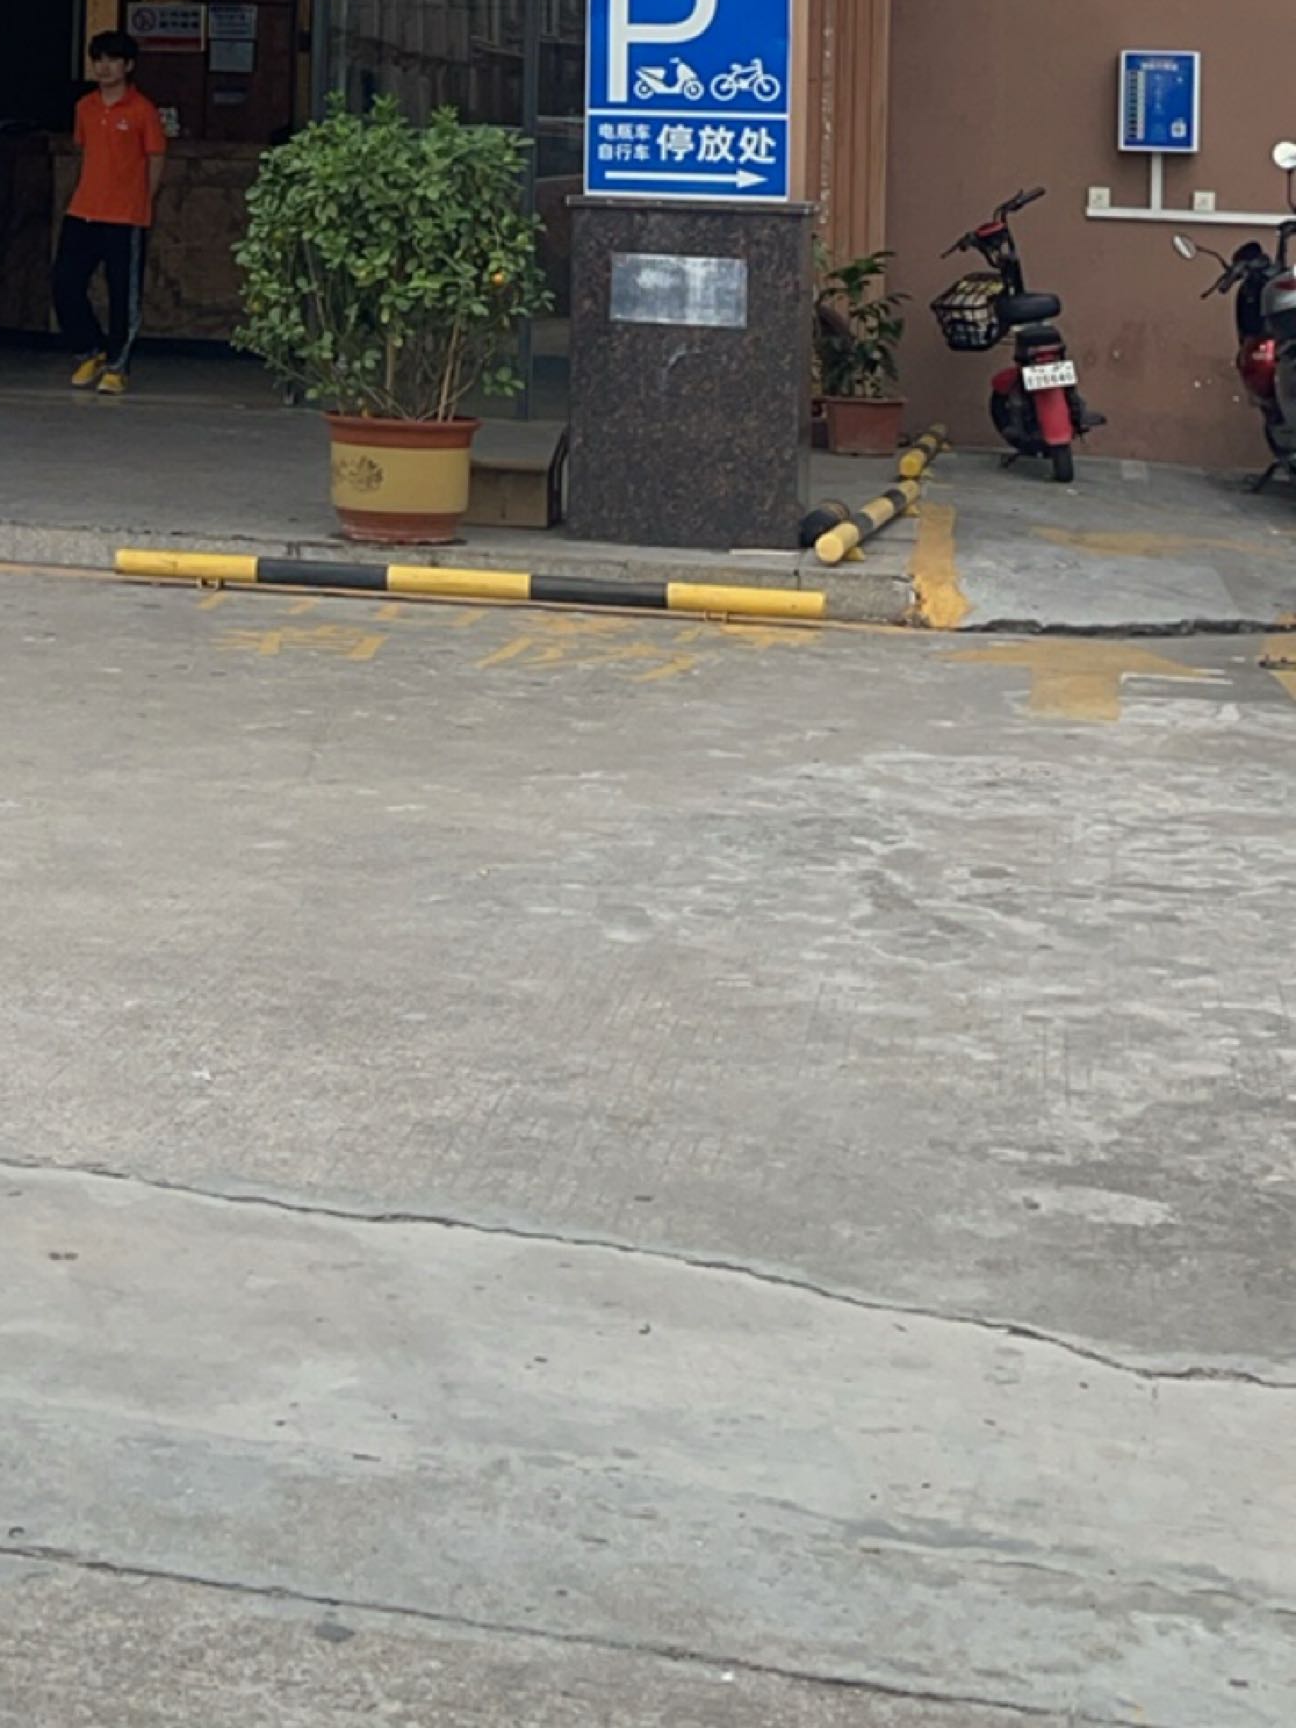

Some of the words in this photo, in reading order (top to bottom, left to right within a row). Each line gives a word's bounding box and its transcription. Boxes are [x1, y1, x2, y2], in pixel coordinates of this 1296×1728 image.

[598, 123, 650, 141] 电瓶车
[598, 143, 650, 161] 自行车
[656, 124, 777, 164] 停放处
